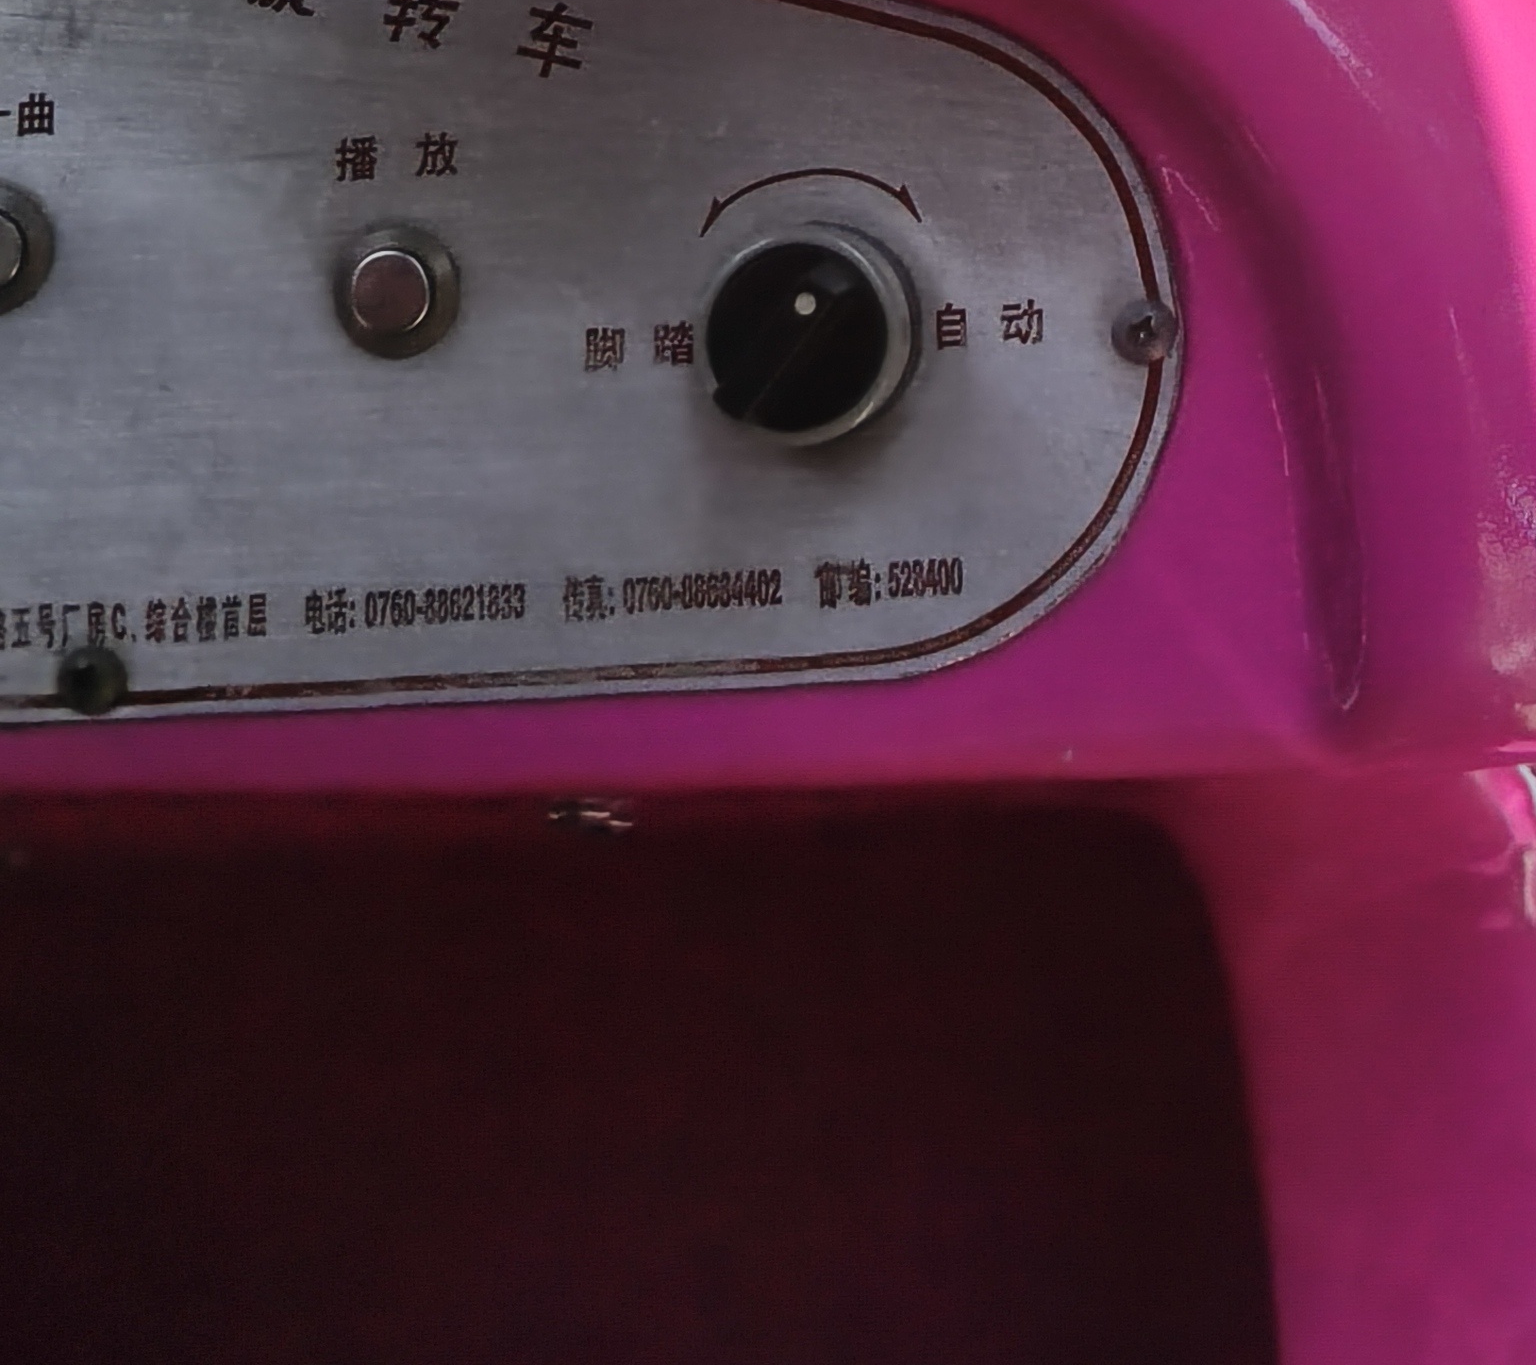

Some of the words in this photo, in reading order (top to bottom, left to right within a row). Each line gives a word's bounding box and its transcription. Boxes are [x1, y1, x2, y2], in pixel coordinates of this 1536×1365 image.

[334, 134, 458, 182] 播放
[584, 320, 694, 372] 脚踏
[936, 300, 1044, 351] 自动
